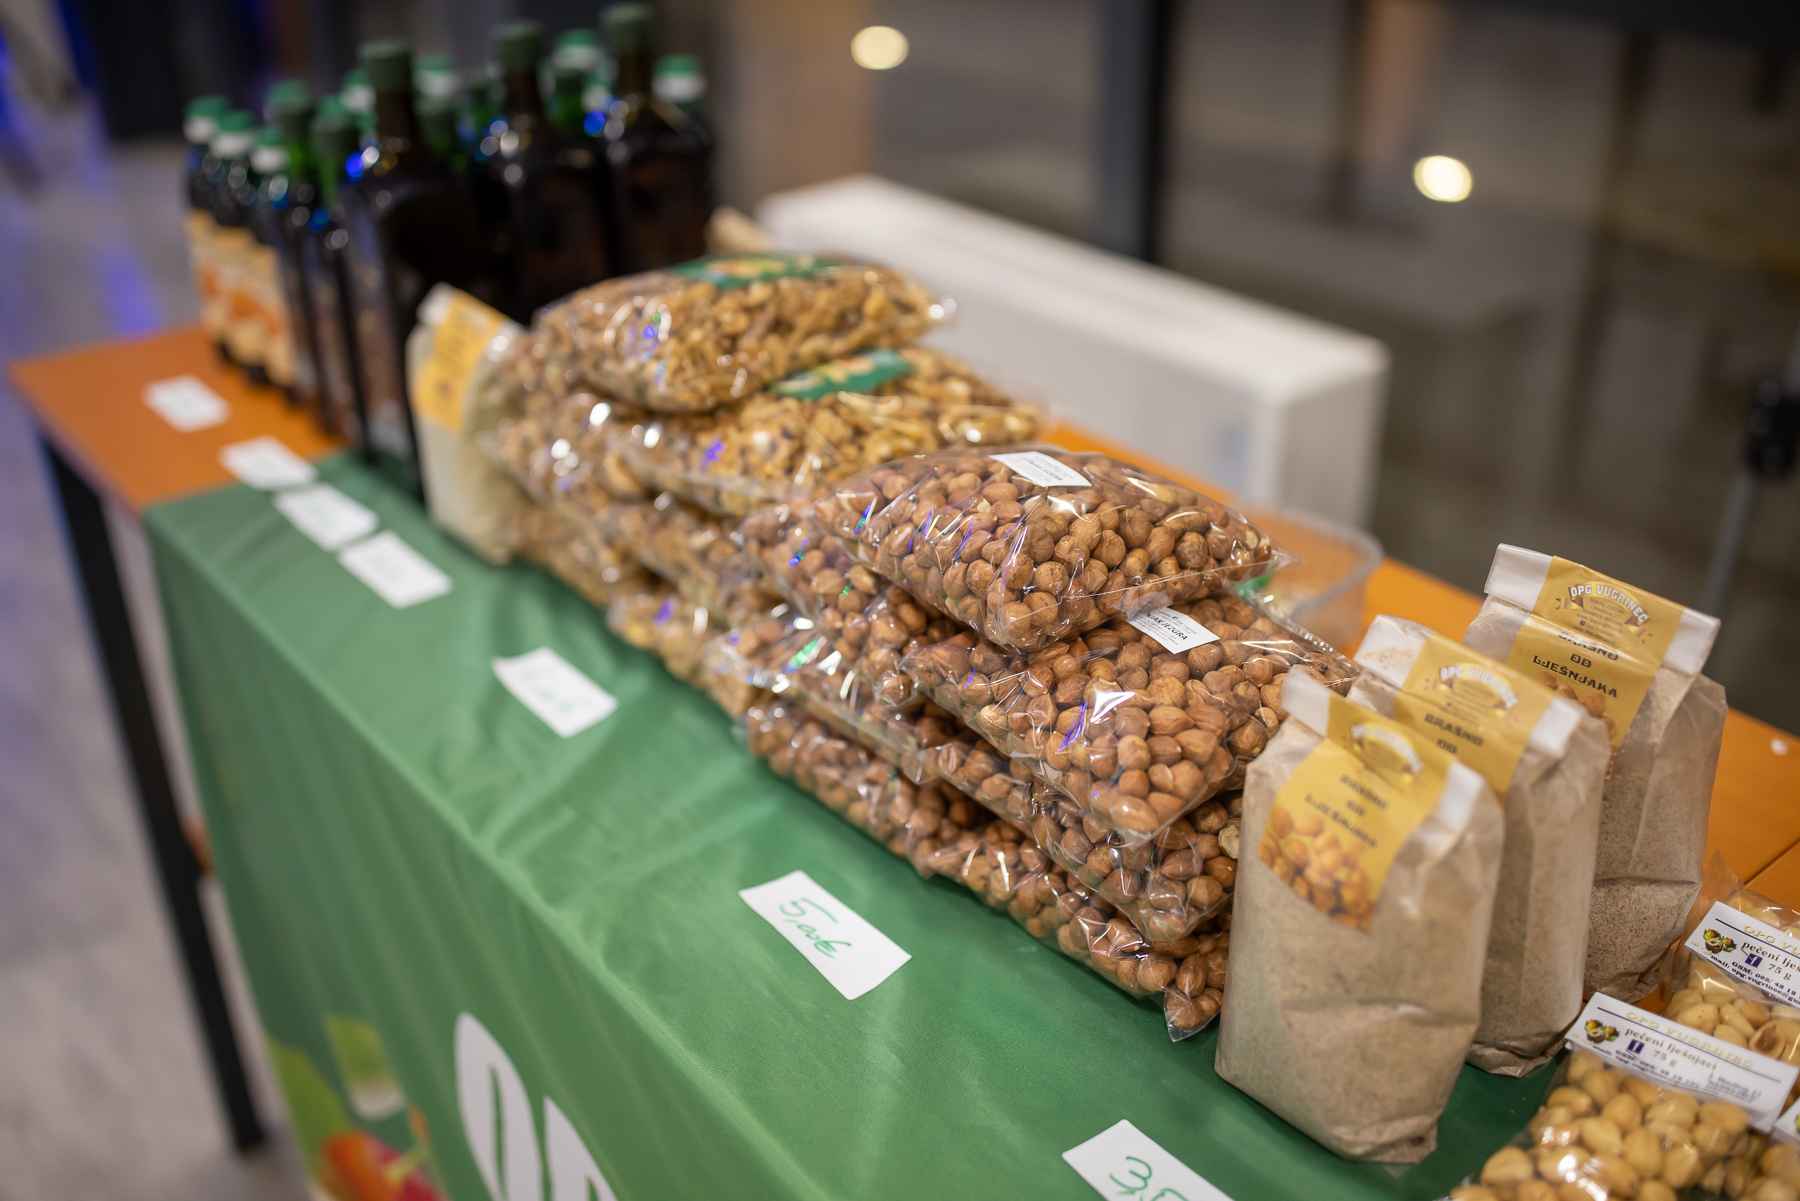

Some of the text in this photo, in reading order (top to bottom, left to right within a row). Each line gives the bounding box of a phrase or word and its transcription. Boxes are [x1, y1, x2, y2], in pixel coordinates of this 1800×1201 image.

[1570, 653, 1592, 668] OD
[1532, 655, 1617, 698] LJEŠNJAKA
[1741, 942, 1781, 962] pečeni
[1768, 963, 1782, 975] 75
[1624, 1028, 1665, 1048] pečeni
